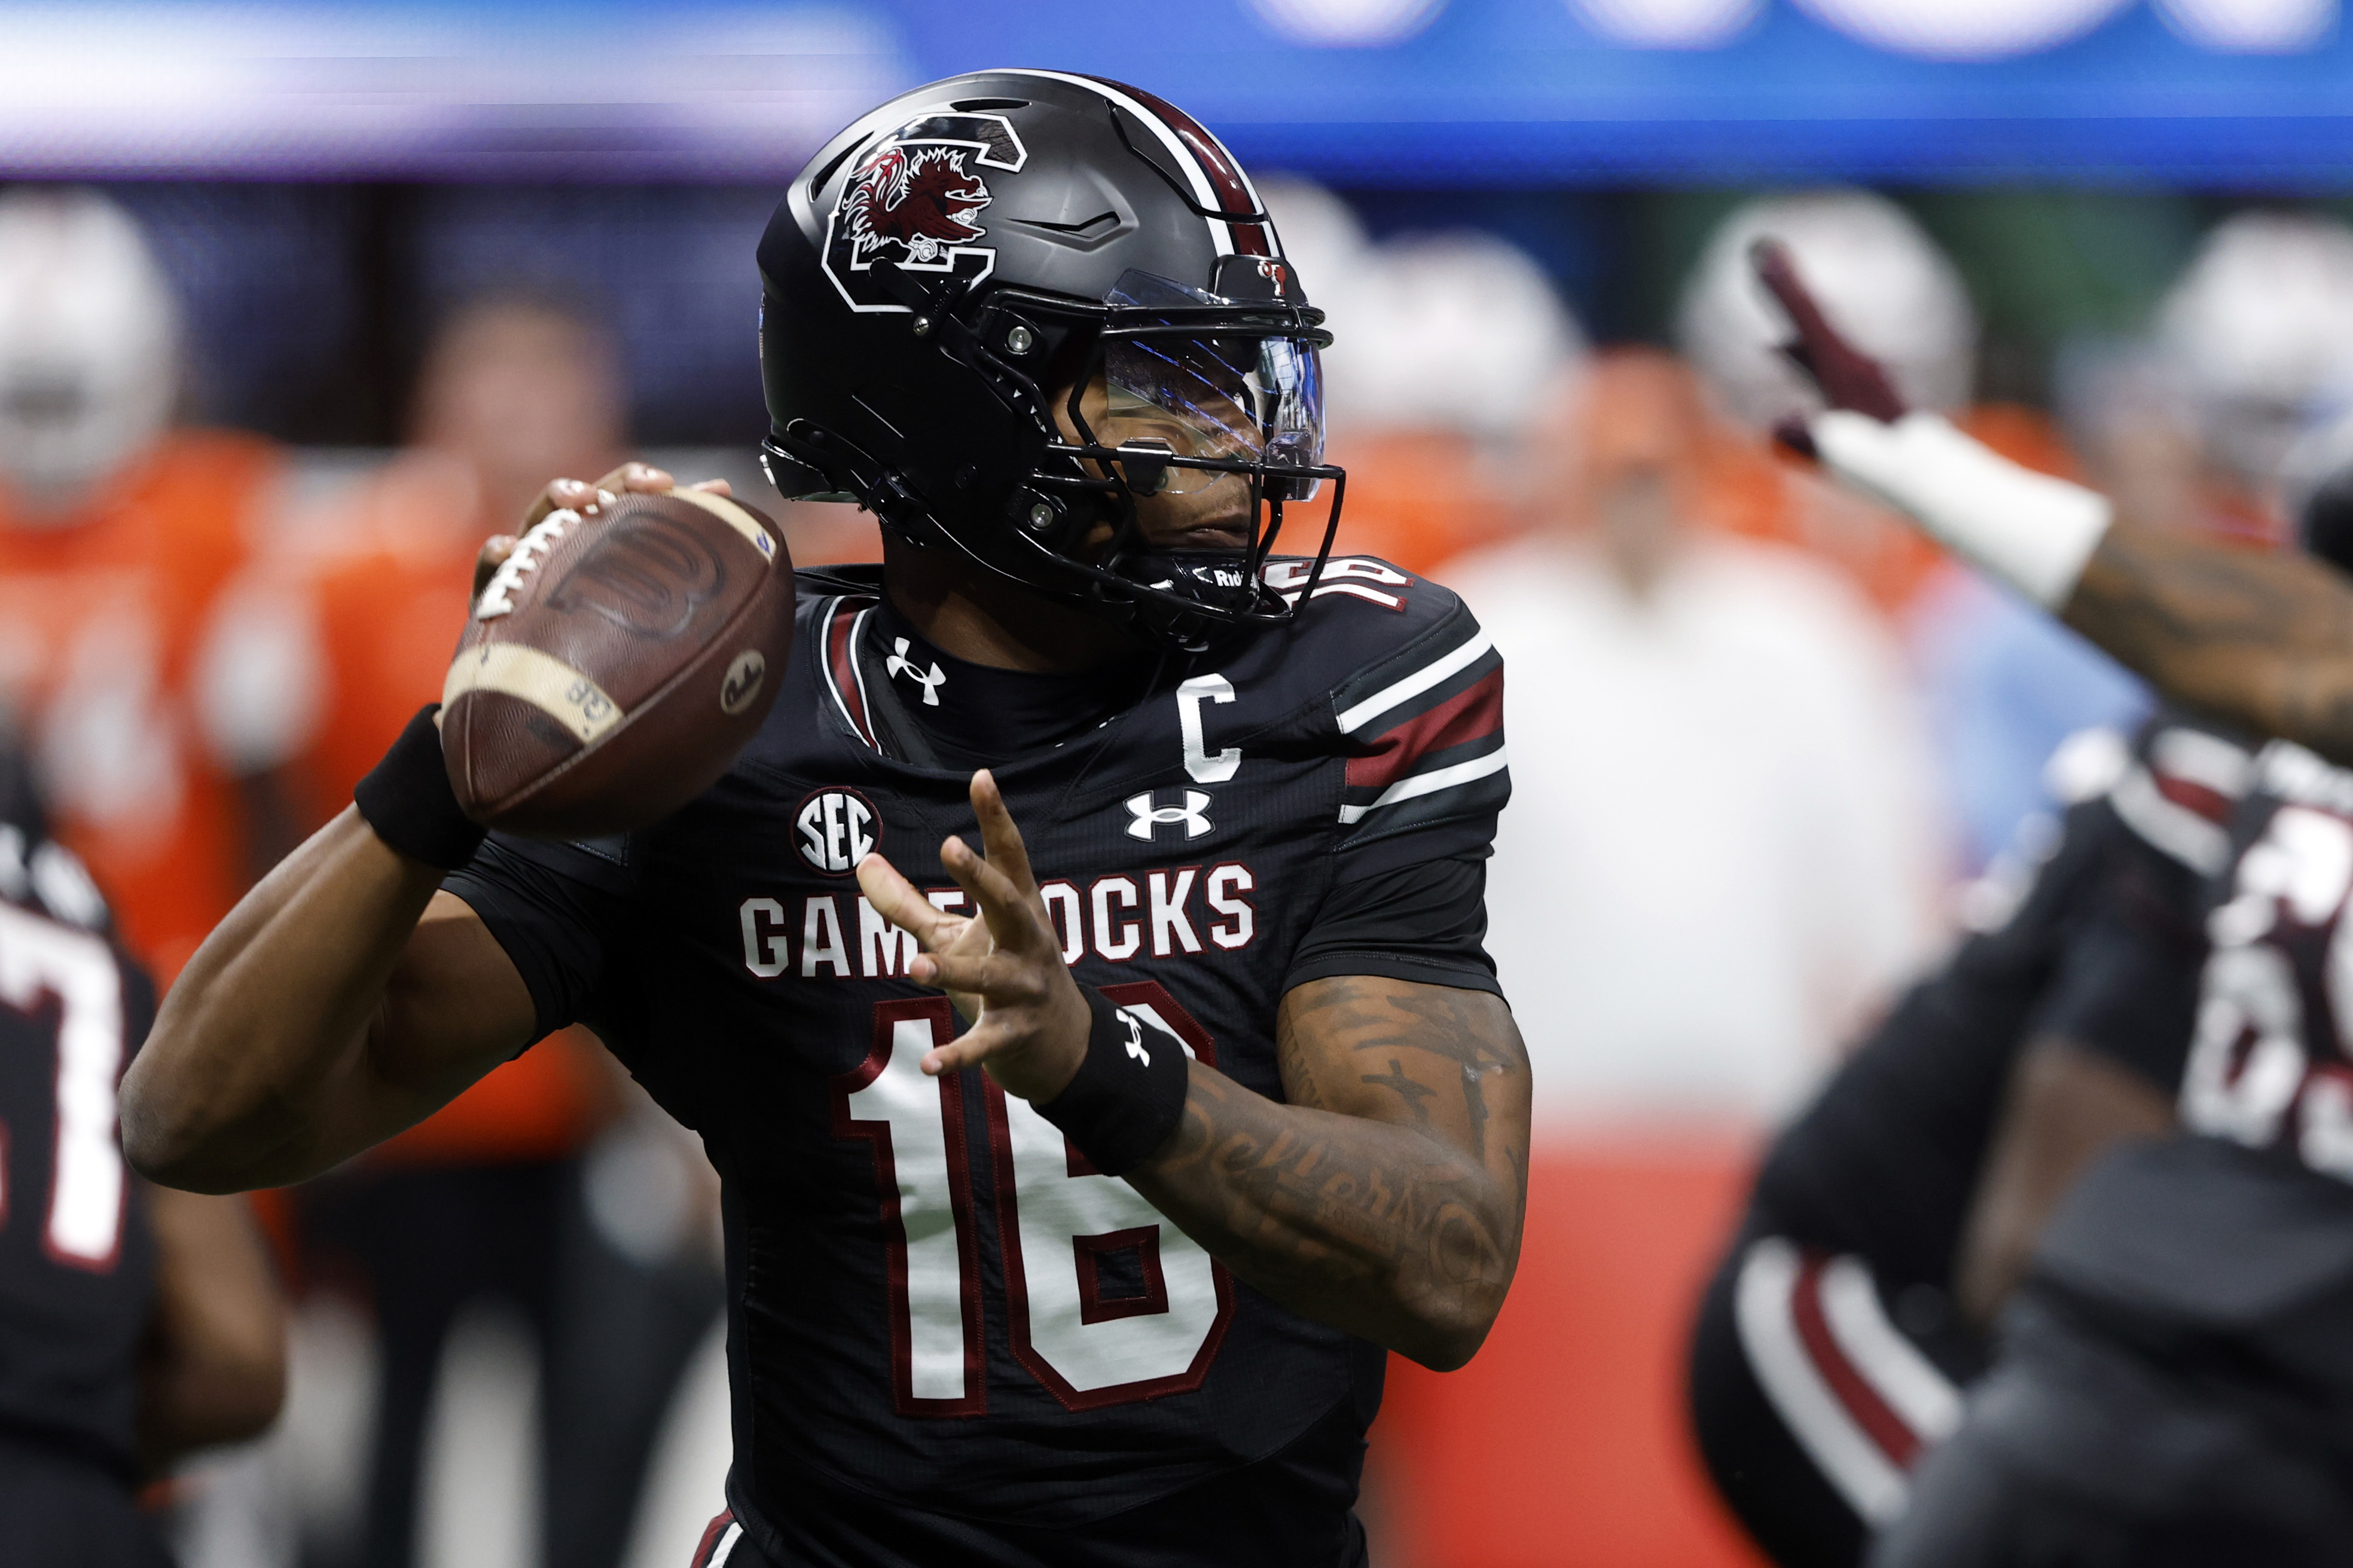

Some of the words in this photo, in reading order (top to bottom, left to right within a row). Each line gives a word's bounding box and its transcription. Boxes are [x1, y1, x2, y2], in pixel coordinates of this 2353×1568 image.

[1176, 673, 1243, 784] C
[796, 793, 874, 871] SEC
[833, 981, 1237, 1419] 16
